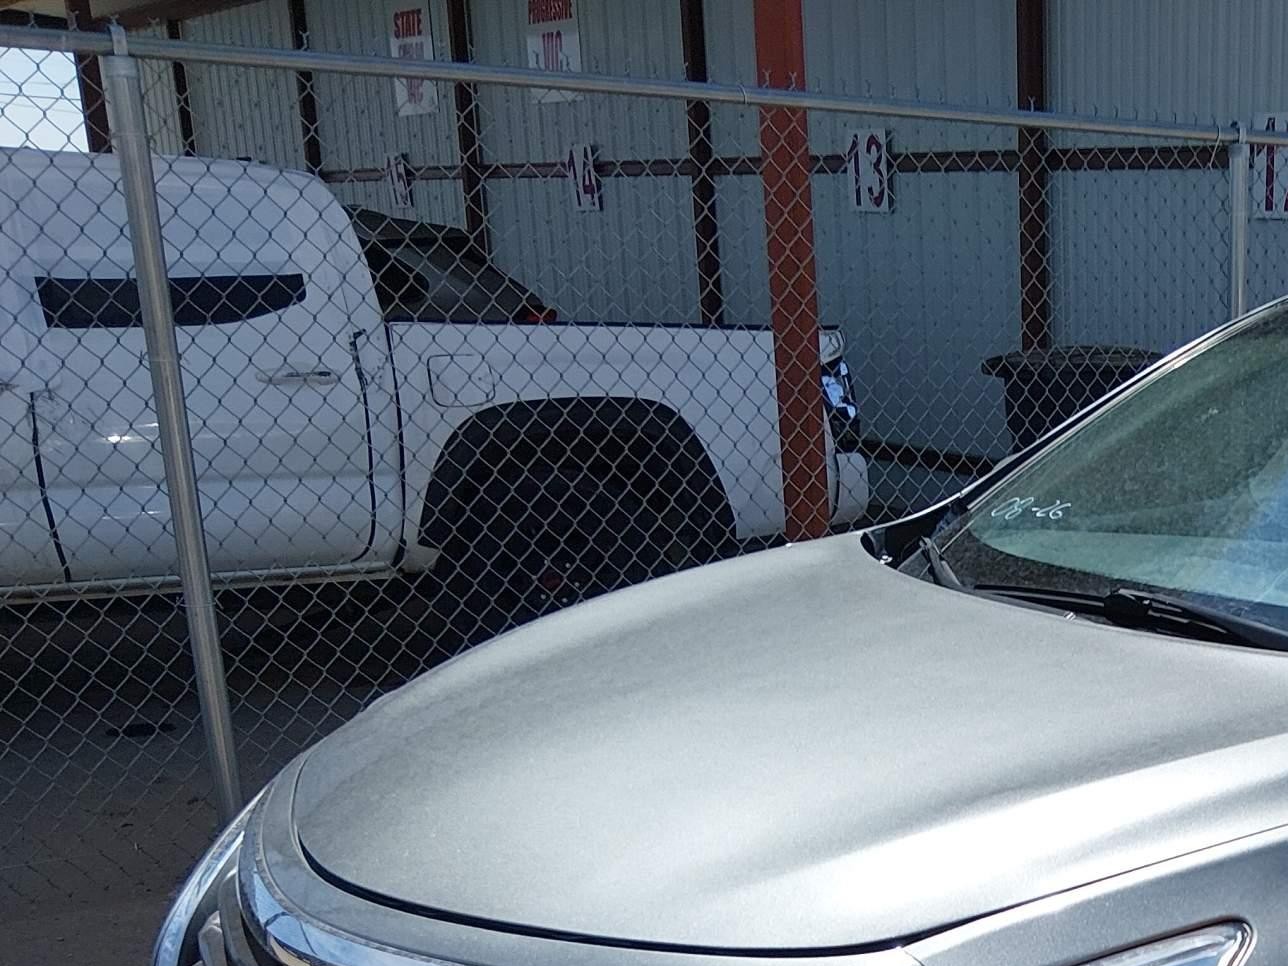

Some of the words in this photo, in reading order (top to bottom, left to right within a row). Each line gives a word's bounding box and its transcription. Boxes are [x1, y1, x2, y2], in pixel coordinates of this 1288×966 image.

[394, 8, 422, 39] STATE
[567, 146, 600, 208] 14
[848, 133, 886, 208] 13
